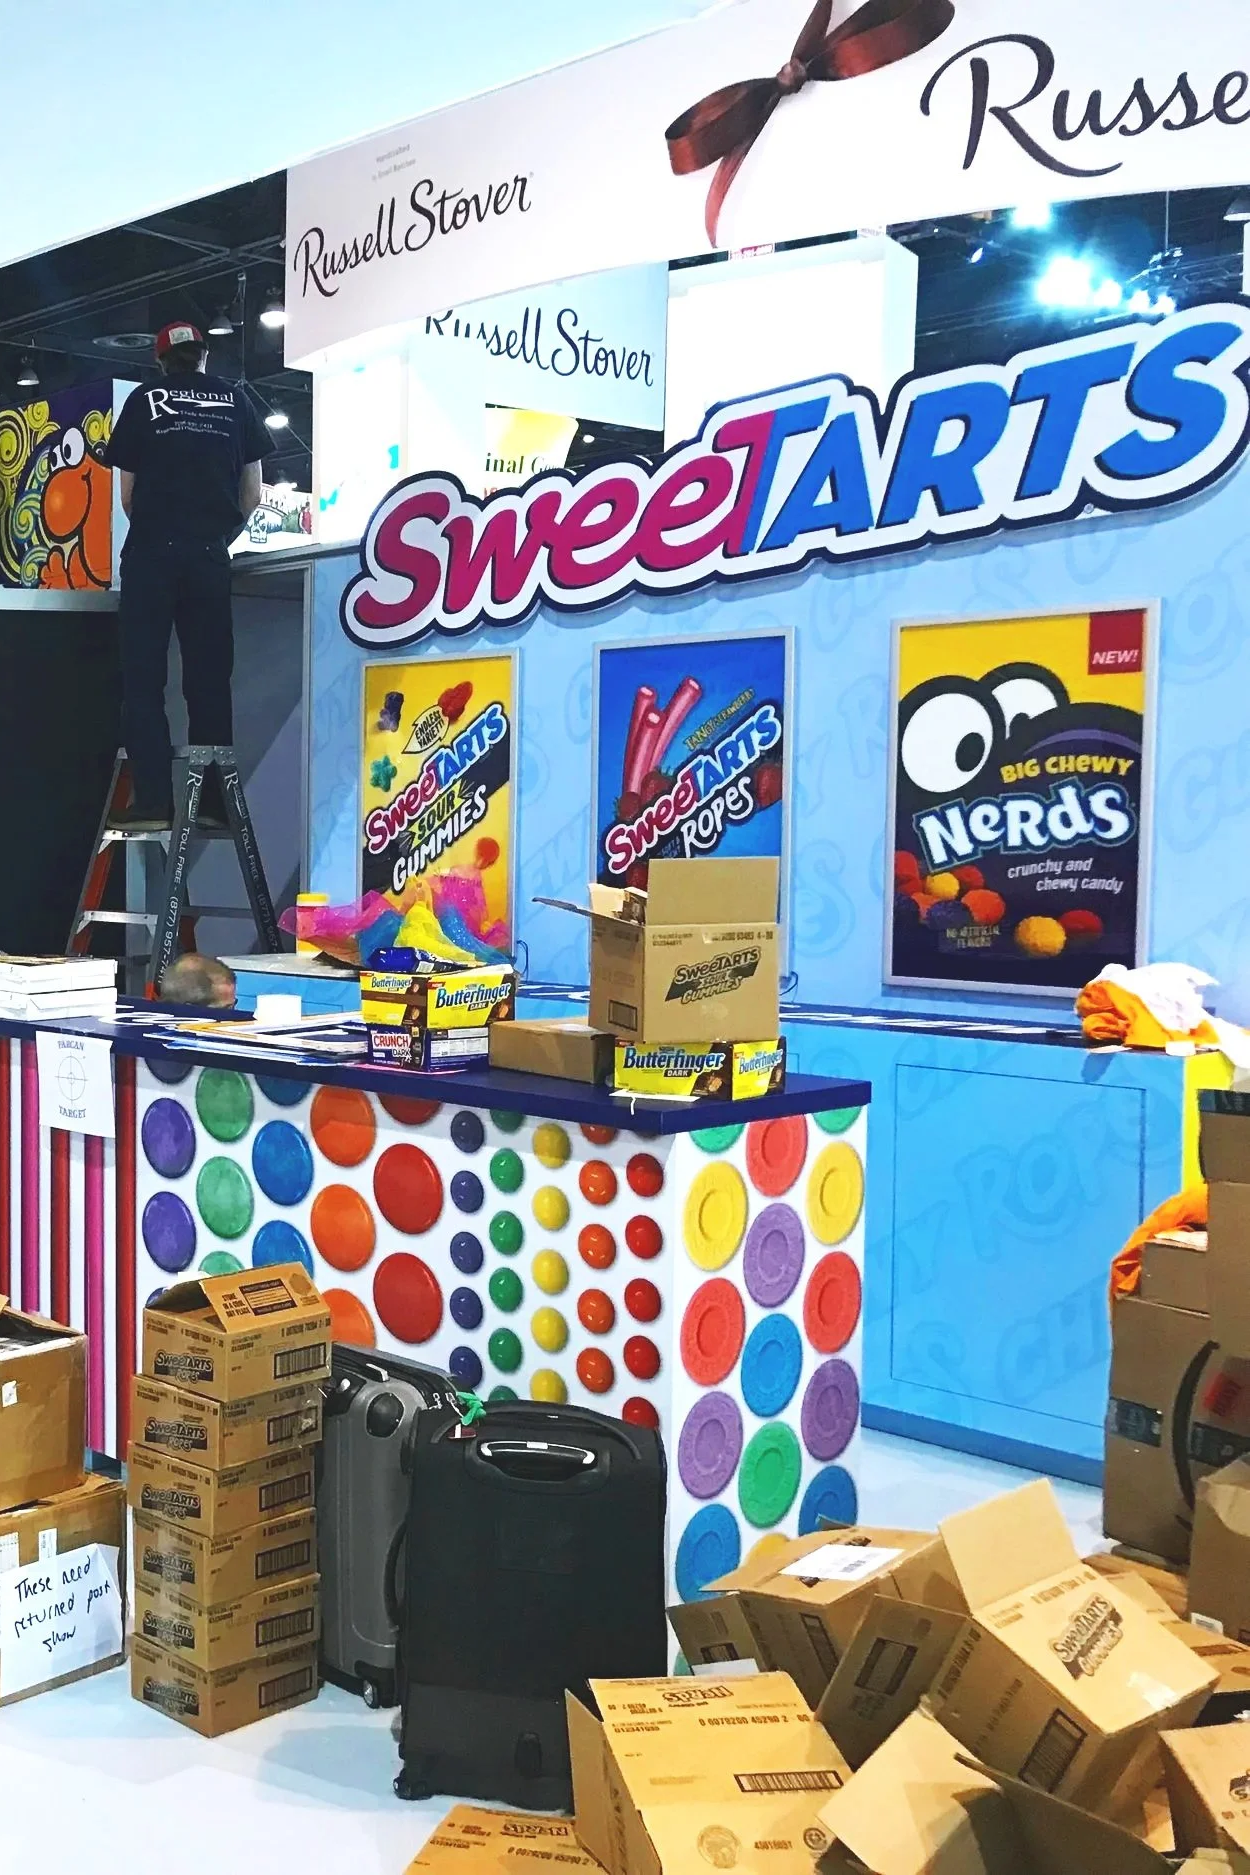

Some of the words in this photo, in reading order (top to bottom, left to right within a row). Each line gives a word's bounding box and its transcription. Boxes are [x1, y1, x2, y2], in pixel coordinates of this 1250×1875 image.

[294, 196, 404, 298] Russell
[405, 175, 531, 251] Stover
[552, 308, 654, 387] Stover
[144, 388, 234, 421] Regional
[1092, 649, 1139, 666] NEW!
[1000, 756, 1041, 784] BIG
[416, 789, 455, 840] SOUR
[179, 826, 191, 856] TOLL
[241, 826, 251, 853] TOLL
[393, 785, 487, 893] GUMMIES
[173, 856, 185, 885] FREE
[1007, 859, 1062, 880] crunchy
[1065, 857, 1094, 872] and
[1036, 875, 1078, 892] chewy
[1081, 876, 1124, 894] candy
[168, 896, 179, 928] (877)
[371, 975, 412, 989] Butterfinger
[682, 976, 742, 1004] GUMMIES
[436, 983, 512, 1009] Butterfinger
[373, 1035, 409, 1048] CRUNCH
[392, 1048, 411, 1057] DARK
[624, 1047, 724, 1072] Butterfinger
[667, 1069, 688, 1077] DARK
[59, 1105, 86, 1118] TARGET
[15, 1576, 52, 1602] These
[62, 1554, 91, 1585] need
[14, 1594, 75, 1638] returned
[43, 1627, 76, 1653] show
